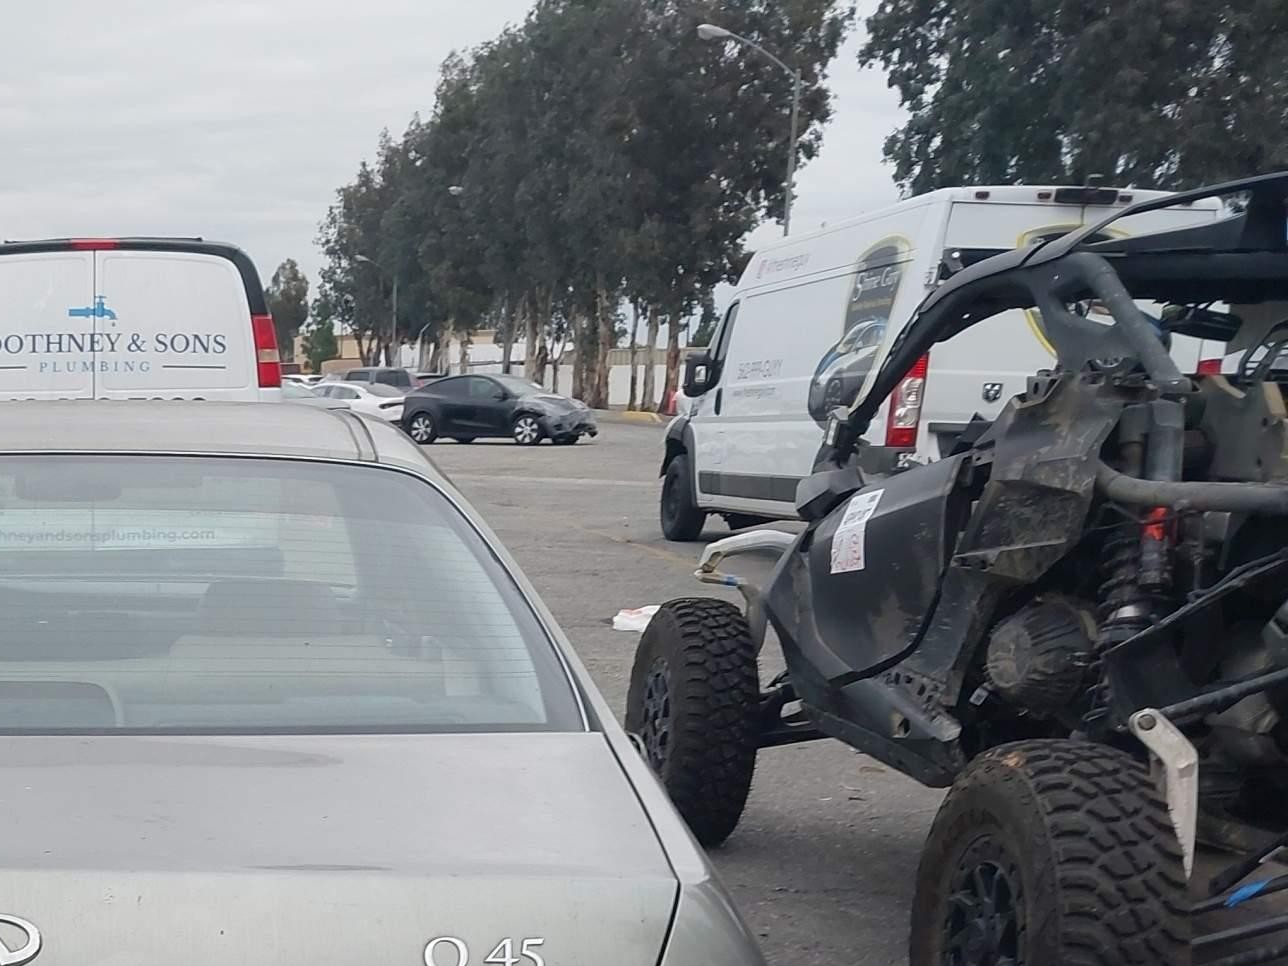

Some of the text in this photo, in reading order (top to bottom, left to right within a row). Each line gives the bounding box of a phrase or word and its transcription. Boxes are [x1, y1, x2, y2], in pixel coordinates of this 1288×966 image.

[127, 333, 147, 353] &
[154, 334, 227, 354] SONS
[39, 361, 152, 373] PLUMBING
